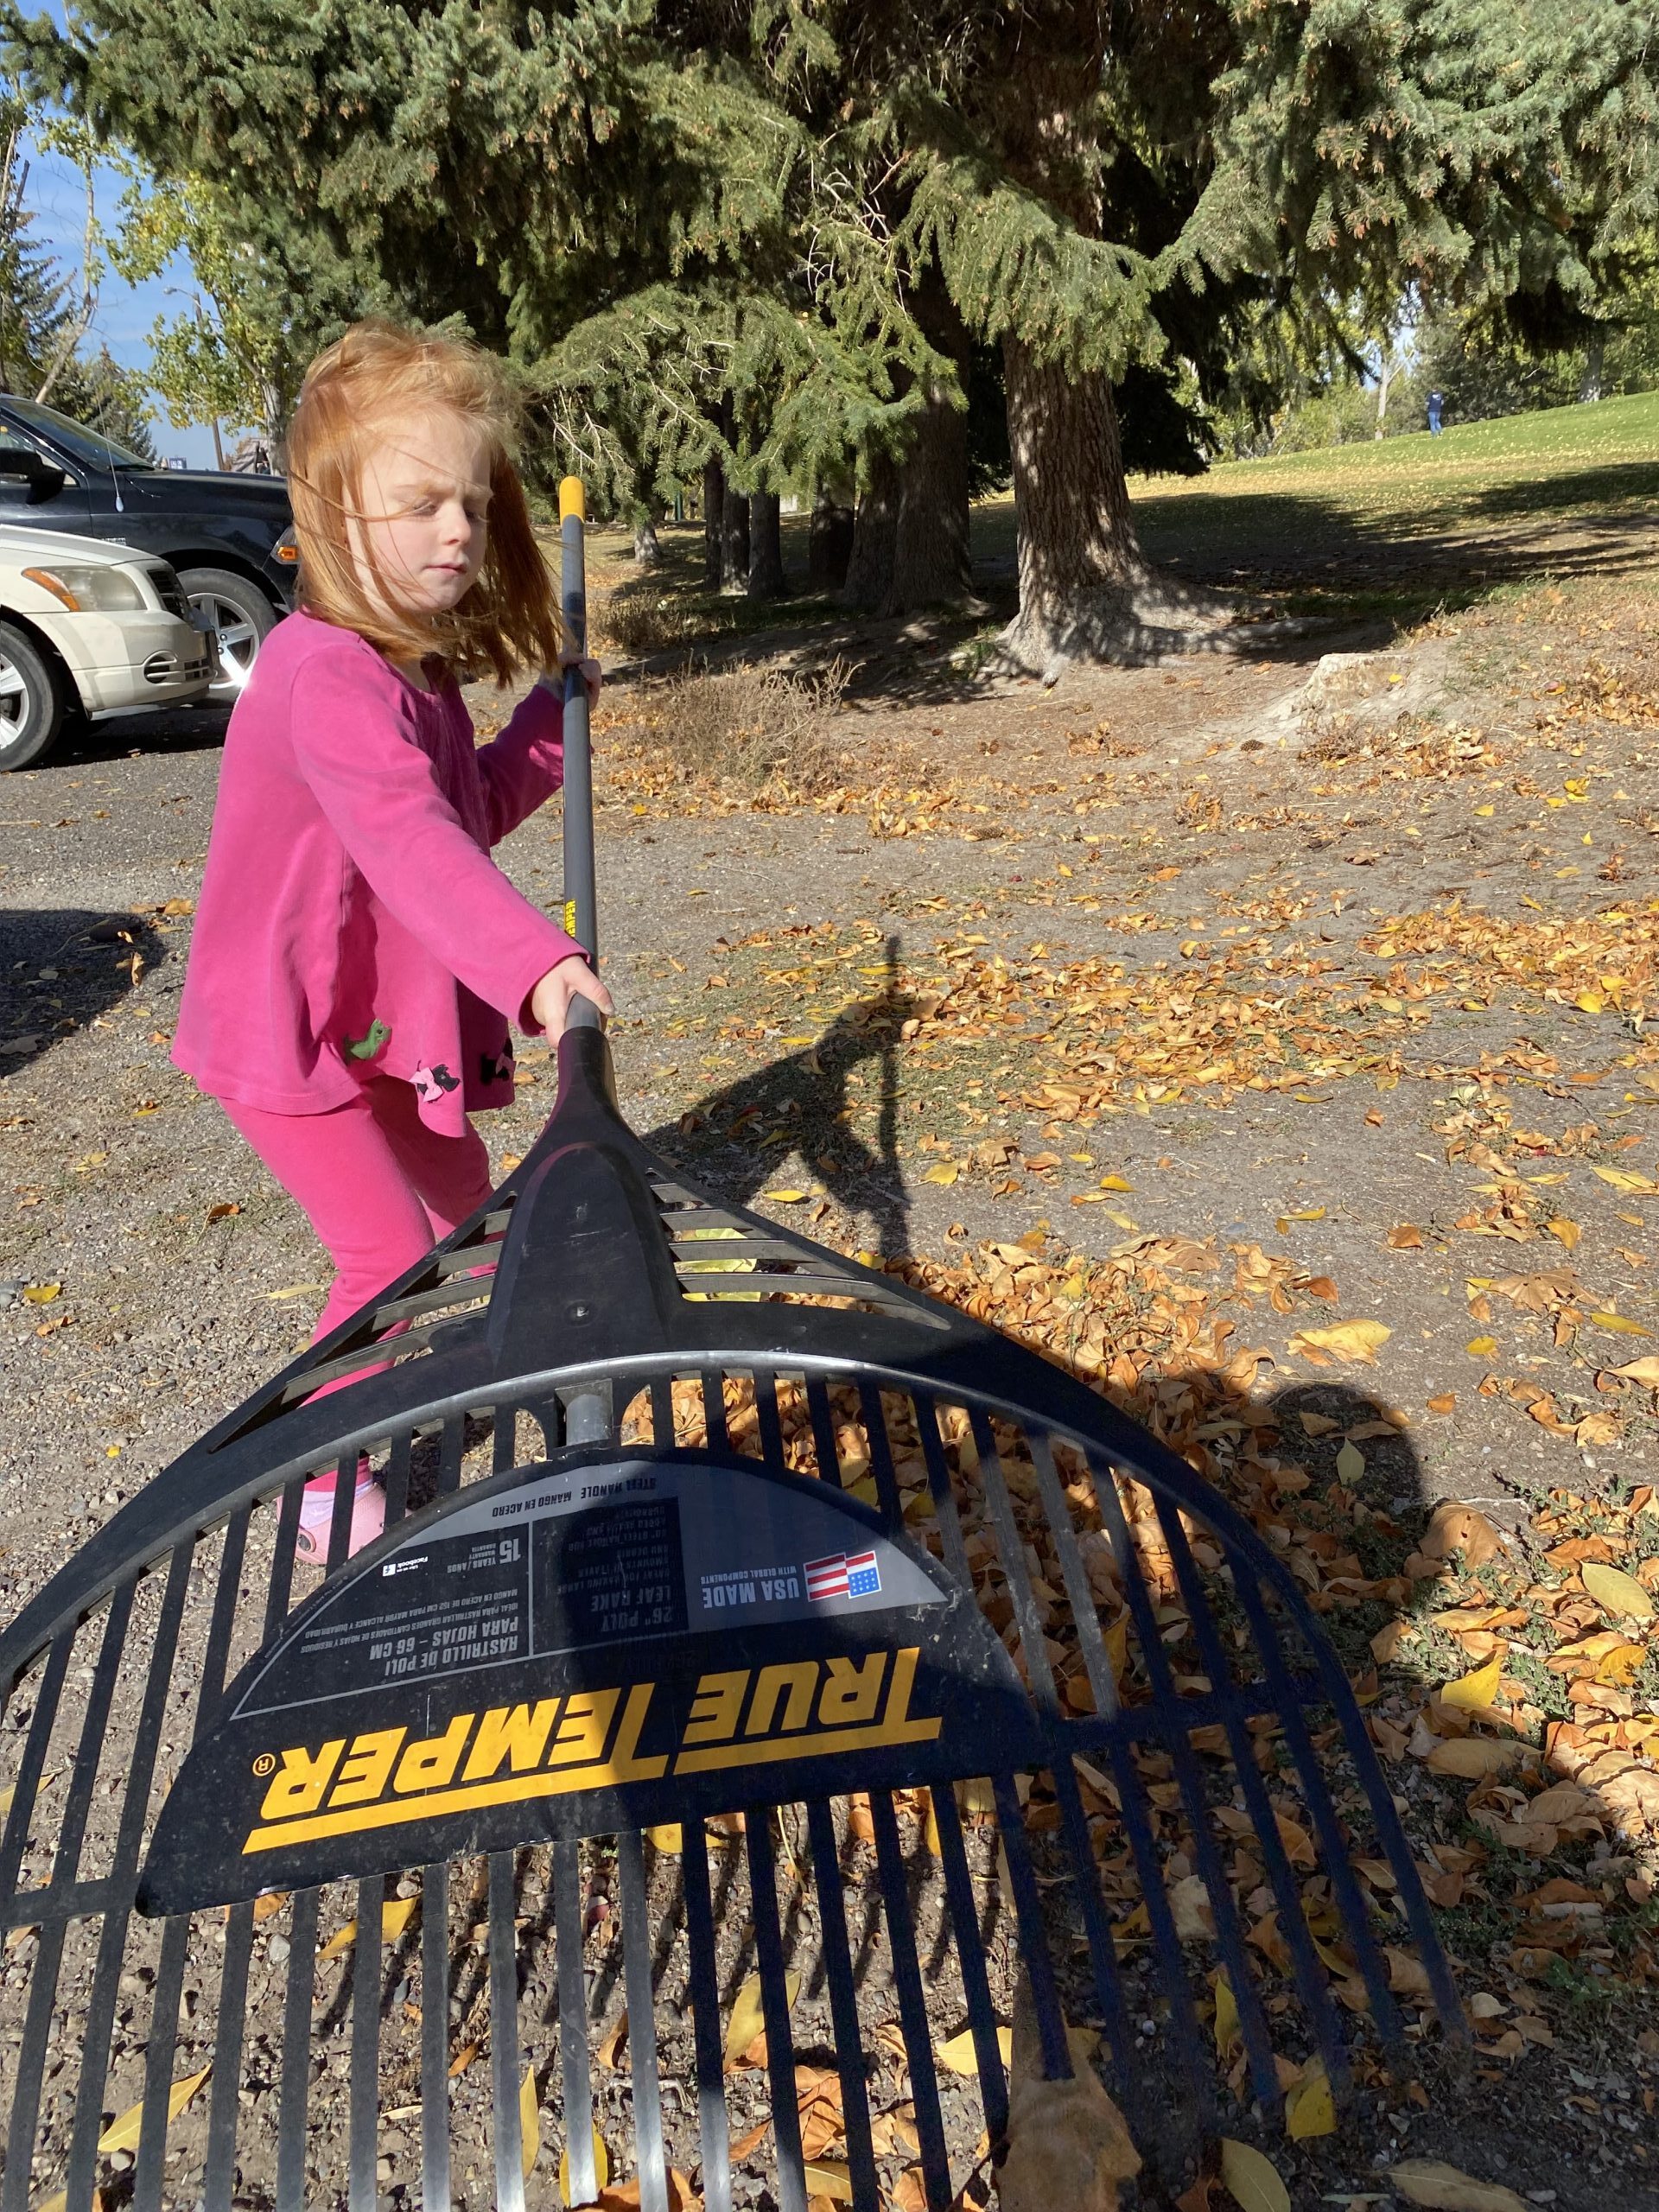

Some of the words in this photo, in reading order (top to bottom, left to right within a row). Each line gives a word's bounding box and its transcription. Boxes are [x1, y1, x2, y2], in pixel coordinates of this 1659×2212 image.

[563, 899, 576, 938] EMPER
[581, 1483, 622, 1499] HANDLE
[626, 1478, 656, 1491] STEEL
[524, 1500, 536, 1510] EN
[538, 1491, 571, 1507] MANGO
[493, 1503, 523, 1517] ACERO
[499, 1538, 521, 1564] 15
[397, 1556, 428, 1568] Facebook
[473, 1558, 496, 1568] YEARS
[750, 1568, 776, 1577] GLOBAL
[778, 1566, 797, 1574] WITH
[701, 1571, 748, 1584] COMPONENTS
[493, 1589, 518, 1599] MANGO
[636, 1585, 671, 1604] LEAF
[702, 1583, 755, 1608] MADE
[761, 1578, 799, 1601] USA
[461, 1595, 482, 1606] ACERO
[484, 1593, 492, 1602] EN
[590, 1591, 631, 1611] RAKE
[409, 1606, 426, 1618] PARA
[427, 1604, 437, 1613] CM
[439, 1601, 450, 1611] 152
[482, 1605, 499, 1615] PARA
[500, 1603, 518, 1611] IDEAL
[355, 1616, 384, 1628] ALCANCE
[385, 1611, 408, 1623] MAYOR
[442, 1608, 481, 1623] RASTRILLAR
[601, 1611, 639, 1631] POLY
[349, 1622, 354, 1630] Y
[371, 1622, 410, 1638] CANTIDADES
[412, 1618, 441, 1630] GRANDES
[482, 1617, 518, 1637] PARA
[306, 1624, 348, 1638] DURABILIDAD
[433, 1624, 477, 1645] HOJAS
[301, 1641, 333, 1653] RESIDUOS
[334, 1638, 339, 1647] Y
[340, 1635, 360, 1646] HOJAS
[397, 1637, 415, 1652] 66
[369, 1643, 392, 1659] CM
[442, 1635, 518, 1663] RASTRILLO
[385, 1656, 416, 1675] POLI
[421, 1651, 437, 1667] DE
[674, 1647, 941, 1776] TRUE
